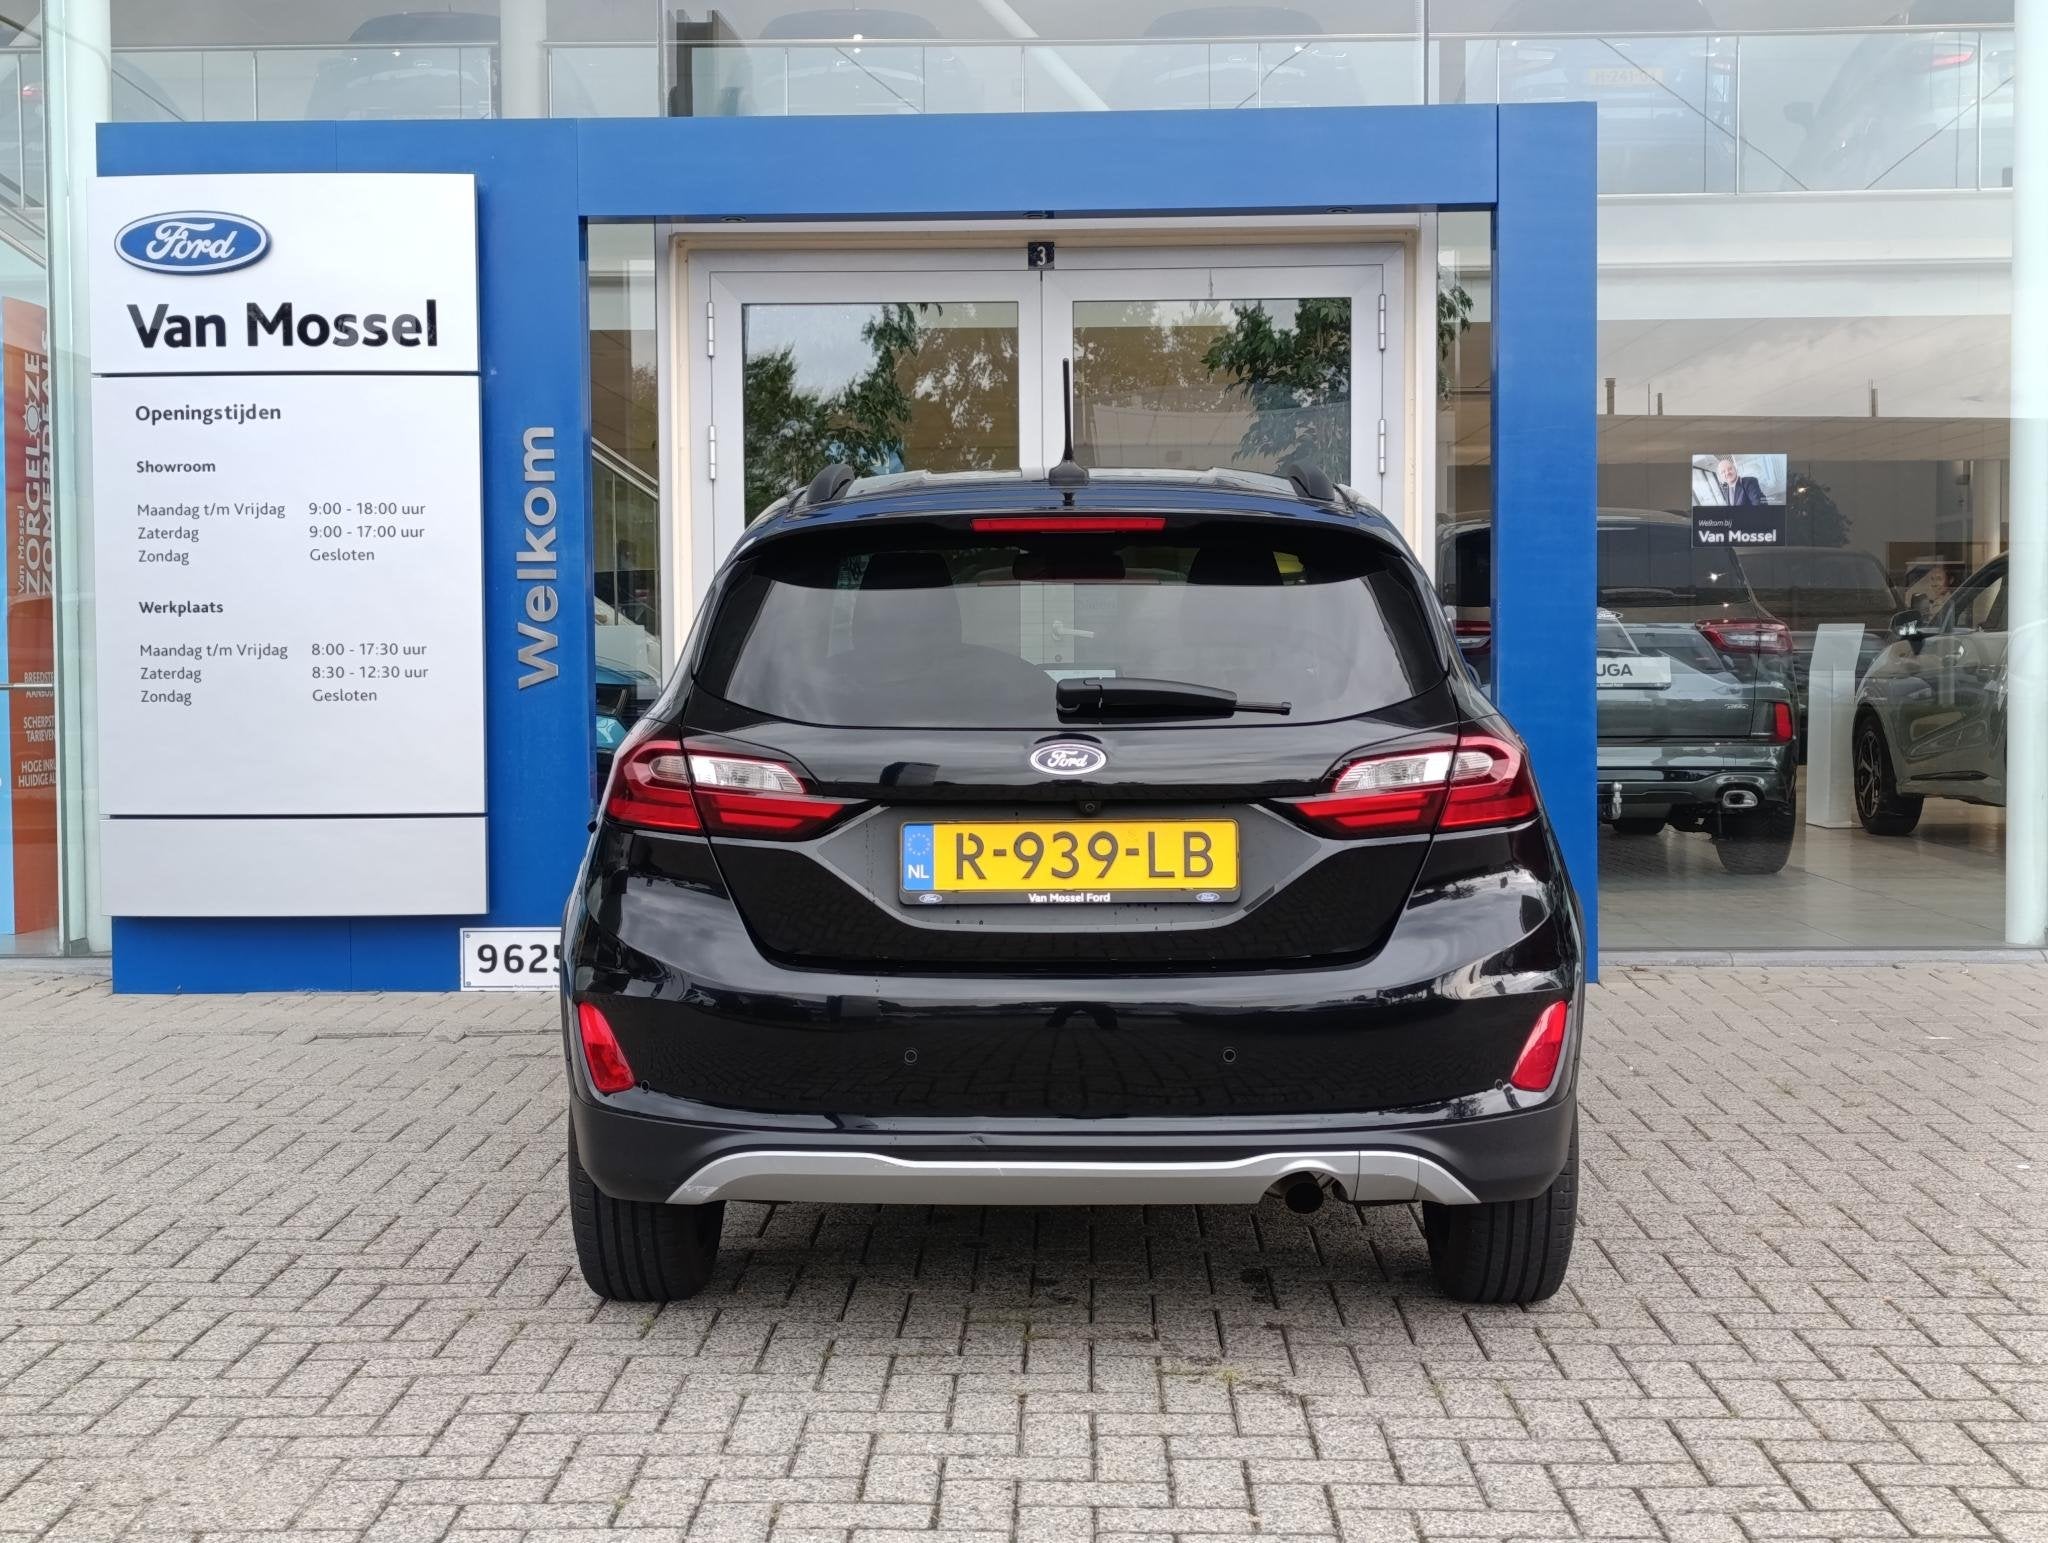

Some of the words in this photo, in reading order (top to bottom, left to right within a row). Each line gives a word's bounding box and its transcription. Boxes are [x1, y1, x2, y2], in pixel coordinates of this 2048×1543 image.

[146, 221, 238, 260] Ford
[1037, 246, 1046, 266] 3
[127, 303, 227, 349] Van
[246, 299, 438, 347] Mossel
[135, 403, 281, 426] Openingstijden
[136, 460, 216, 473] Showroom
[137, 503, 200, 520] Maandag
[203, 502, 230, 516] t/m
[234, 502, 286, 519] Vrijdag
[308, 502, 342, 515] 9:00
[356, 502, 397, 515] 18:00
[401, 505, 426, 515] uur
[1698, 519, 1724, 527] Welkom
[16, 505, 25, 561] Mossel
[138, 526, 200, 543] Zaterdag
[309, 525, 342, 538] 9:00
[356, 525, 397, 538] 17:00
[400, 528, 425, 538] uur
[1698, 530, 1725, 543] Van
[1728, 528, 1777, 542] Mossel
[138, 549, 190, 566] Zondag
[309, 547, 375, 561] Gesloten
[516, 426, 559, 690] Welkom
[17, 565, 26, 594] Van
[138, 600, 224, 617] Werkplaats
[140, 644, 203, 660] Maandag
[206, 643, 233, 657] t/m
[236, 643, 289, 660] Vrijdag
[311, 643, 345, 656] 8:00
[359, 643, 398, 656] 17:30
[402, 645, 427, 655] uur
[140, 667, 202, 684] Zaterdag
[312, 666, 345, 679] 8:30
[359, 666, 400, 679] 12:30
[404, 668, 429, 678] uur
[140, 689, 192, 707] Zondag
[312, 688, 377, 702] Gesloten
[21, 759, 43, 774] HOGE
[1047, 750, 1089, 768] Ford
[955, 830, 1214, 881] R-939-LB
[908, 865, 930, 880] NL
[1028, 892, 1048, 903] Van
[1049, 892, 1084, 903] Mossel
[1086, 892, 1111, 903] Ford
